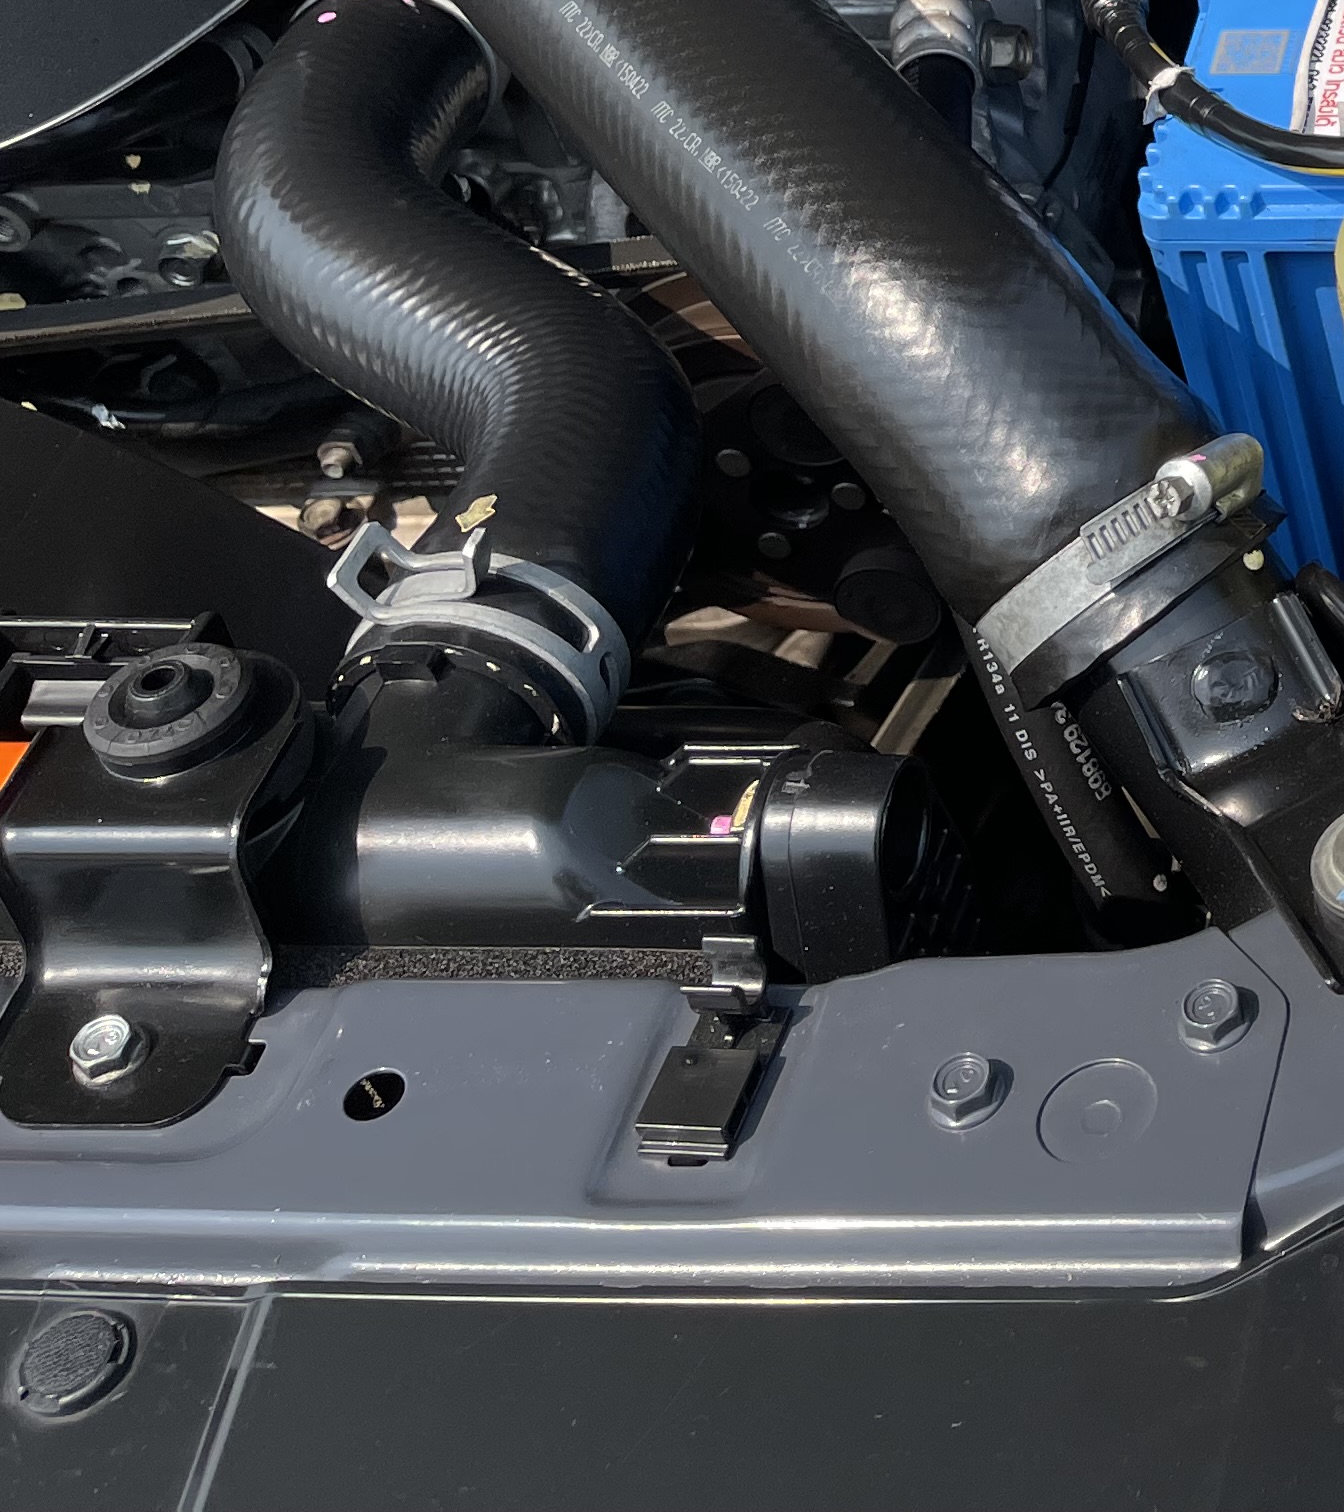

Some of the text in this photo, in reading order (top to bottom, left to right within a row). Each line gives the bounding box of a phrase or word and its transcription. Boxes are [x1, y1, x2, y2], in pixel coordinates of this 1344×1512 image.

[976, 638, 1005, 695] R134a
[1004, 703, 1021, 723] 11
[1015, 729, 1038, 761] DIS
